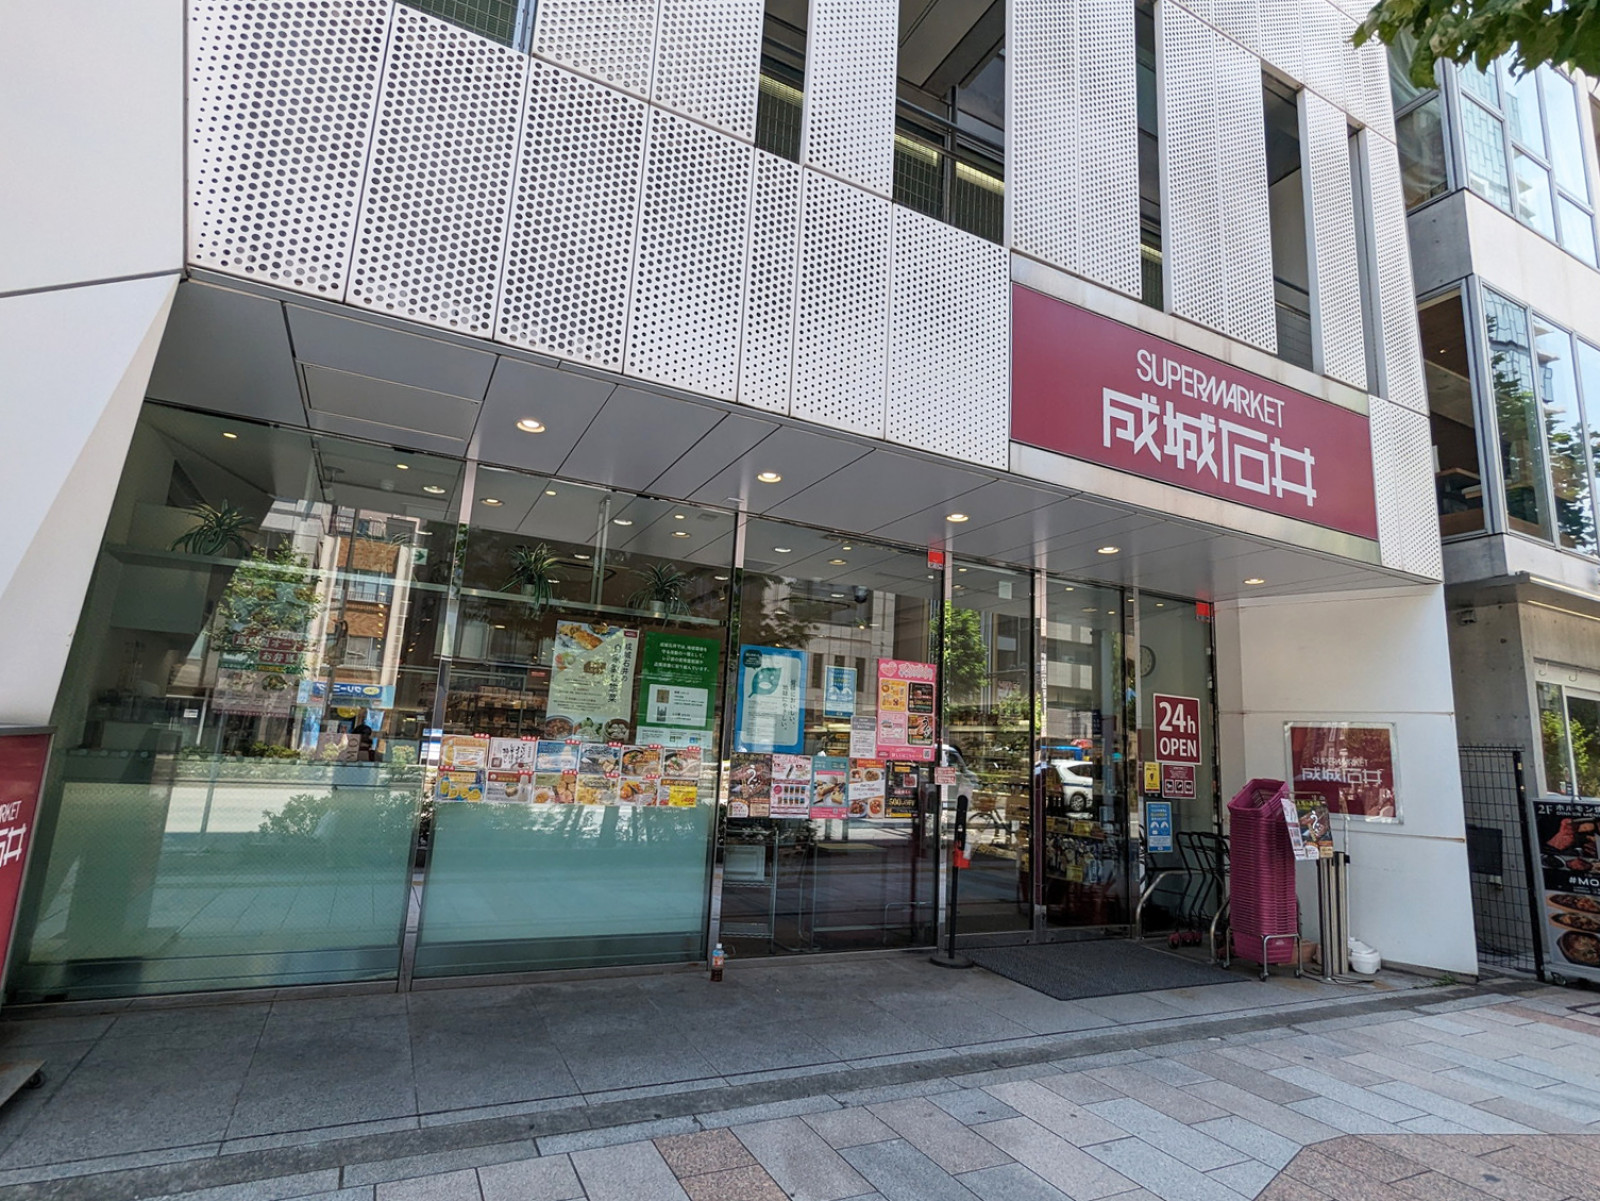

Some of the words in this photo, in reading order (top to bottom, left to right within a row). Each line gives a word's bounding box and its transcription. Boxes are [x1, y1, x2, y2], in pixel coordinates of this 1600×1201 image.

[1136, 349, 1285, 428] SUPERMARKET
[1102, 386, 1318, 507] 成城石井
[1159, 701, 1196, 734] 24h
[1159, 737, 1197, 757] OPEN
[1312, 756, 1368, 767] SUPERMARKET
[1302, 767, 1384, 784] 成城石井
[0, 800, 22, 823] RKET
